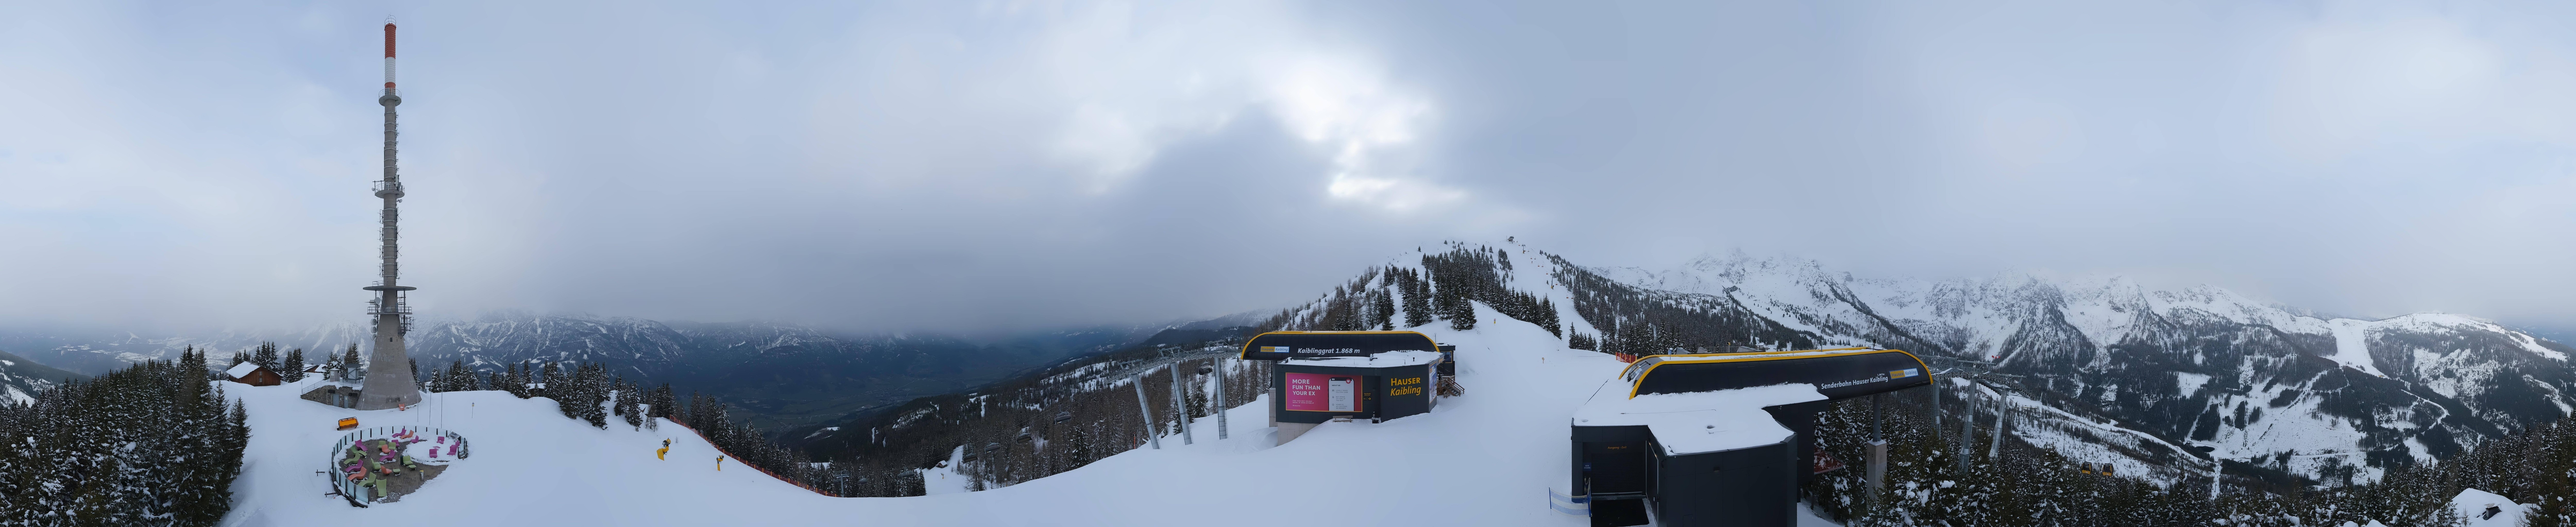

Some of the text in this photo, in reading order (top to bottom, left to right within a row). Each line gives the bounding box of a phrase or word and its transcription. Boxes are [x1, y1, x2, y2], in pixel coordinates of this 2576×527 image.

[1391, 377, 1421, 386] HAUSER
[1821, 381, 1852, 389] Senderbahn
[1391, 386, 1421, 396] Kaibling
